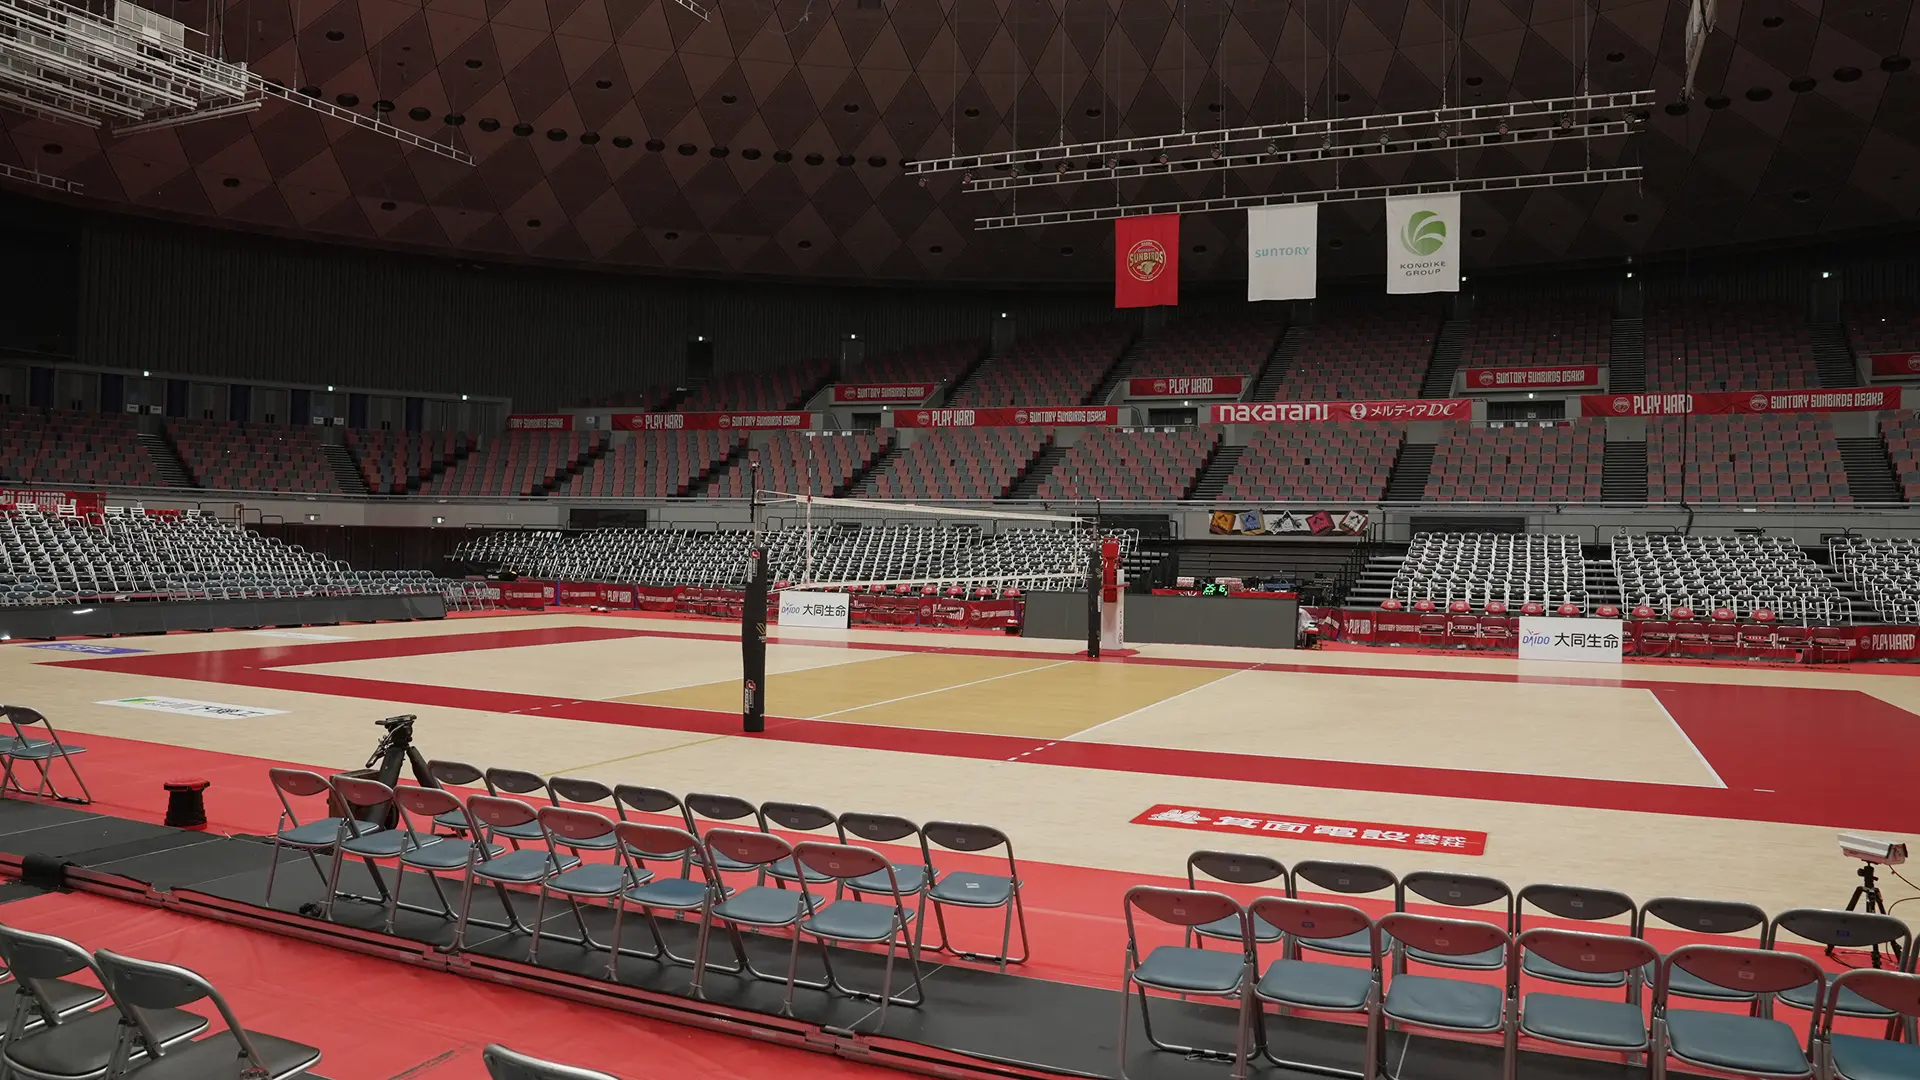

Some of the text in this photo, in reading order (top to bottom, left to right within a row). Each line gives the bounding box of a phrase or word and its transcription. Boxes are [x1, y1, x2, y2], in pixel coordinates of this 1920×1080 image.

[1129, 250, 1163, 267] SUNBIRDS
[1254, 246, 1310, 258] SUNTORY
[1400, 261, 1446, 269] KONOIKE
[1405, 268, 1441, 276] GROUP
[1495, 369, 1585, 384] SUNTORY SUNBIRDS OSAKA
[1168, 377, 1213, 394] PLAY HARD
[1633, 394, 1693, 415] PLAY HARD
[1771, 391, 1883, 409] SUNTORY SUNBIRDS OSAKA
[645, 414, 683, 430] PLAY HARD
[731, 416, 756, 427] SUNTORY
[931, 410, 975, 426] PLAY HARD
[1029, 411, 1056, 423] SUNTORY
[1086, 410, 1106, 422] OSAKA
[1620, 525, 1627, 534] 3
[607, 590, 618, 602] PLAY
[619, 591, 631, 603] HARD
[802, 603, 846, 617] 大同生命
[1522, 632, 1619, 649] DAIDO 大同生命
[1872, 634, 1889, 650] PLAY
[1889, 633, 1916, 650] HARD
